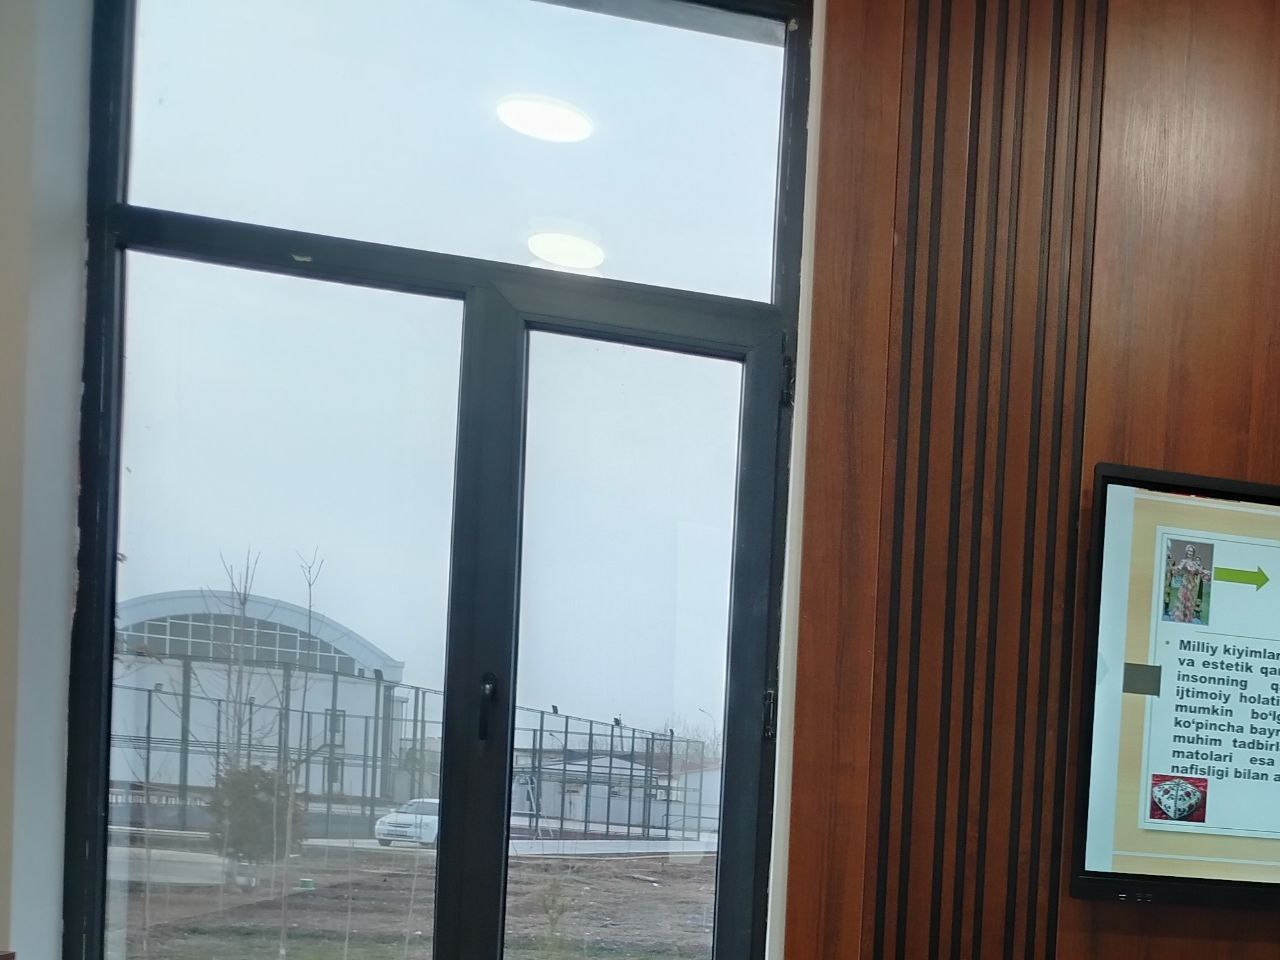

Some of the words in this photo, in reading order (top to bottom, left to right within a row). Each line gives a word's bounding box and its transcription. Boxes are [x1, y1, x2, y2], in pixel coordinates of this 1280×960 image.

[1178, 638, 1219, 657] Milliy
[1177, 657, 1195, 667] va
[1200, 659, 1254, 673] estetik
[1176, 669, 1248, 691] insonning
[1175, 685, 1231, 704] ijtimoiy
[1174, 703, 1233, 717] mumkin
[1172, 733, 1222, 746] muhim
[1171, 749, 1233, 763] matolari
[1248, 756, 1275, 766] esa
[1170, 763, 1229, 780] nafisligi
[1233, 767, 1269, 781] bilan
